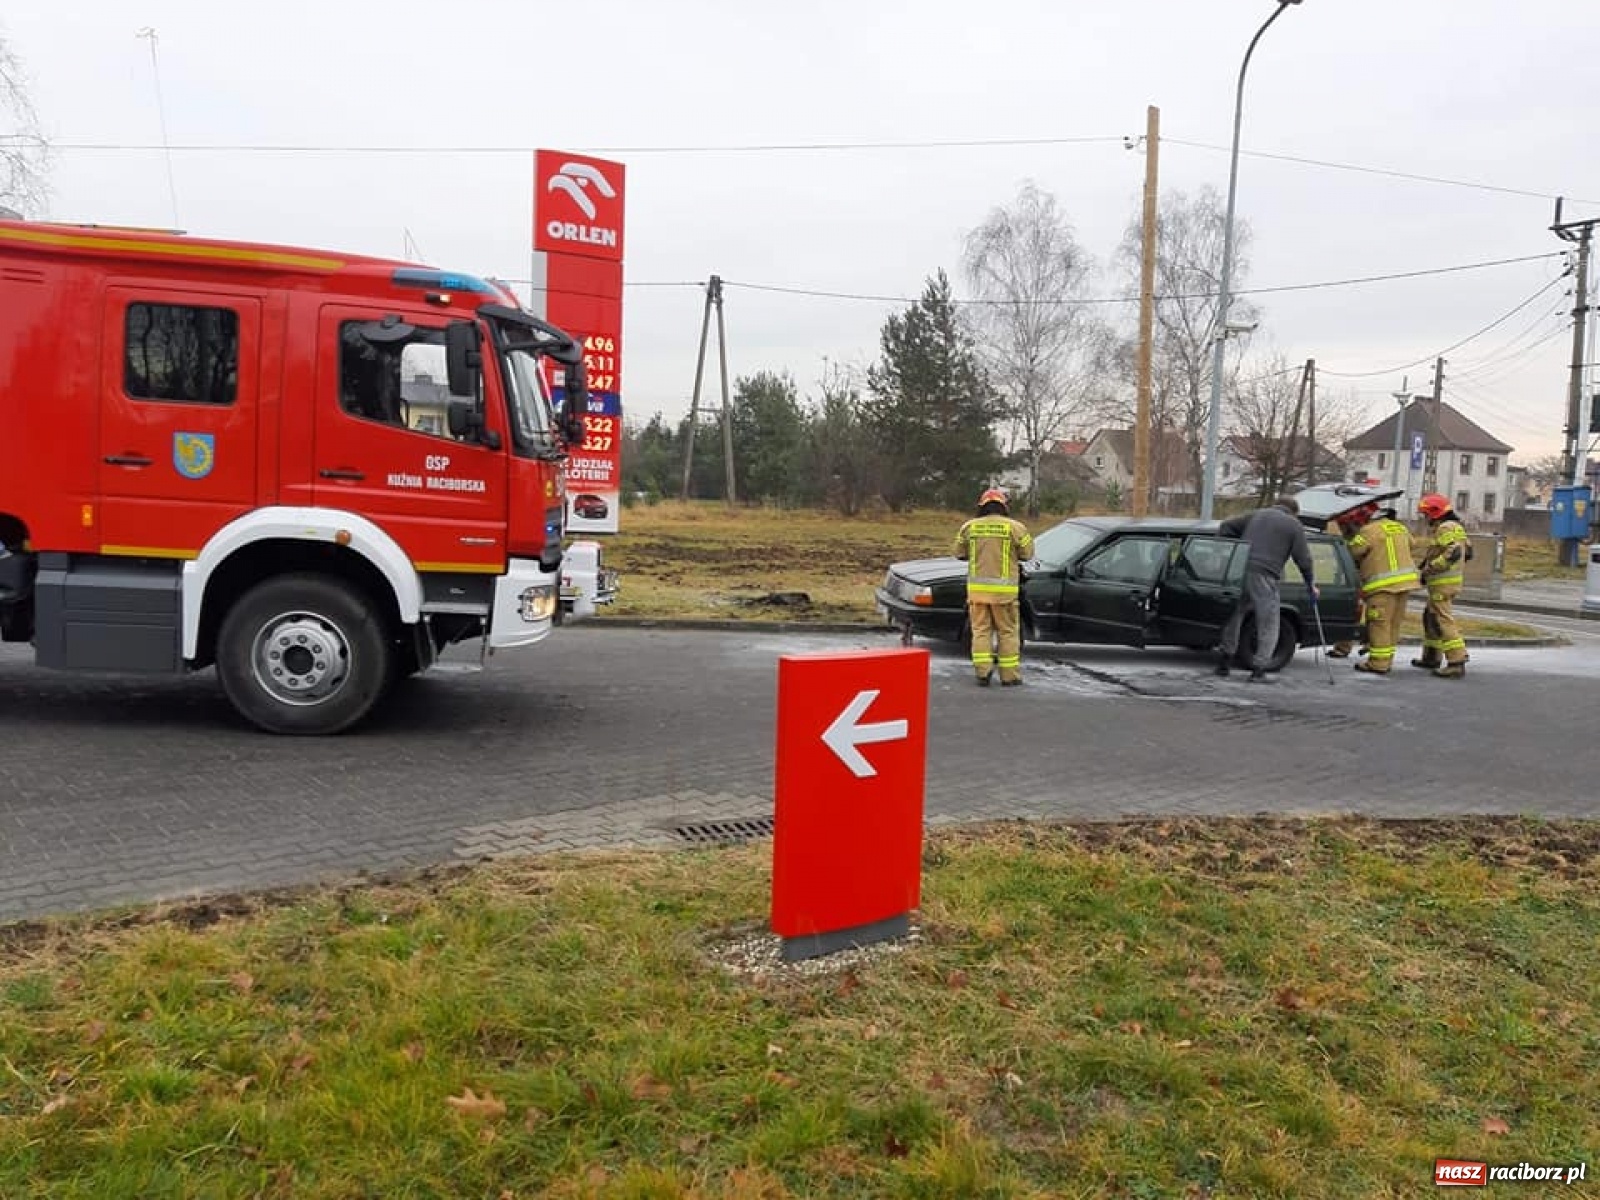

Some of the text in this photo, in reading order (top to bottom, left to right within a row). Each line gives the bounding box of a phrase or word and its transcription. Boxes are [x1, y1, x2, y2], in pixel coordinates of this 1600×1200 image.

[547, 221, 617, 247] ORLEN
[426, 454, 451, 471] OSP
[426, 477, 485, 491] RACIBORSKA
